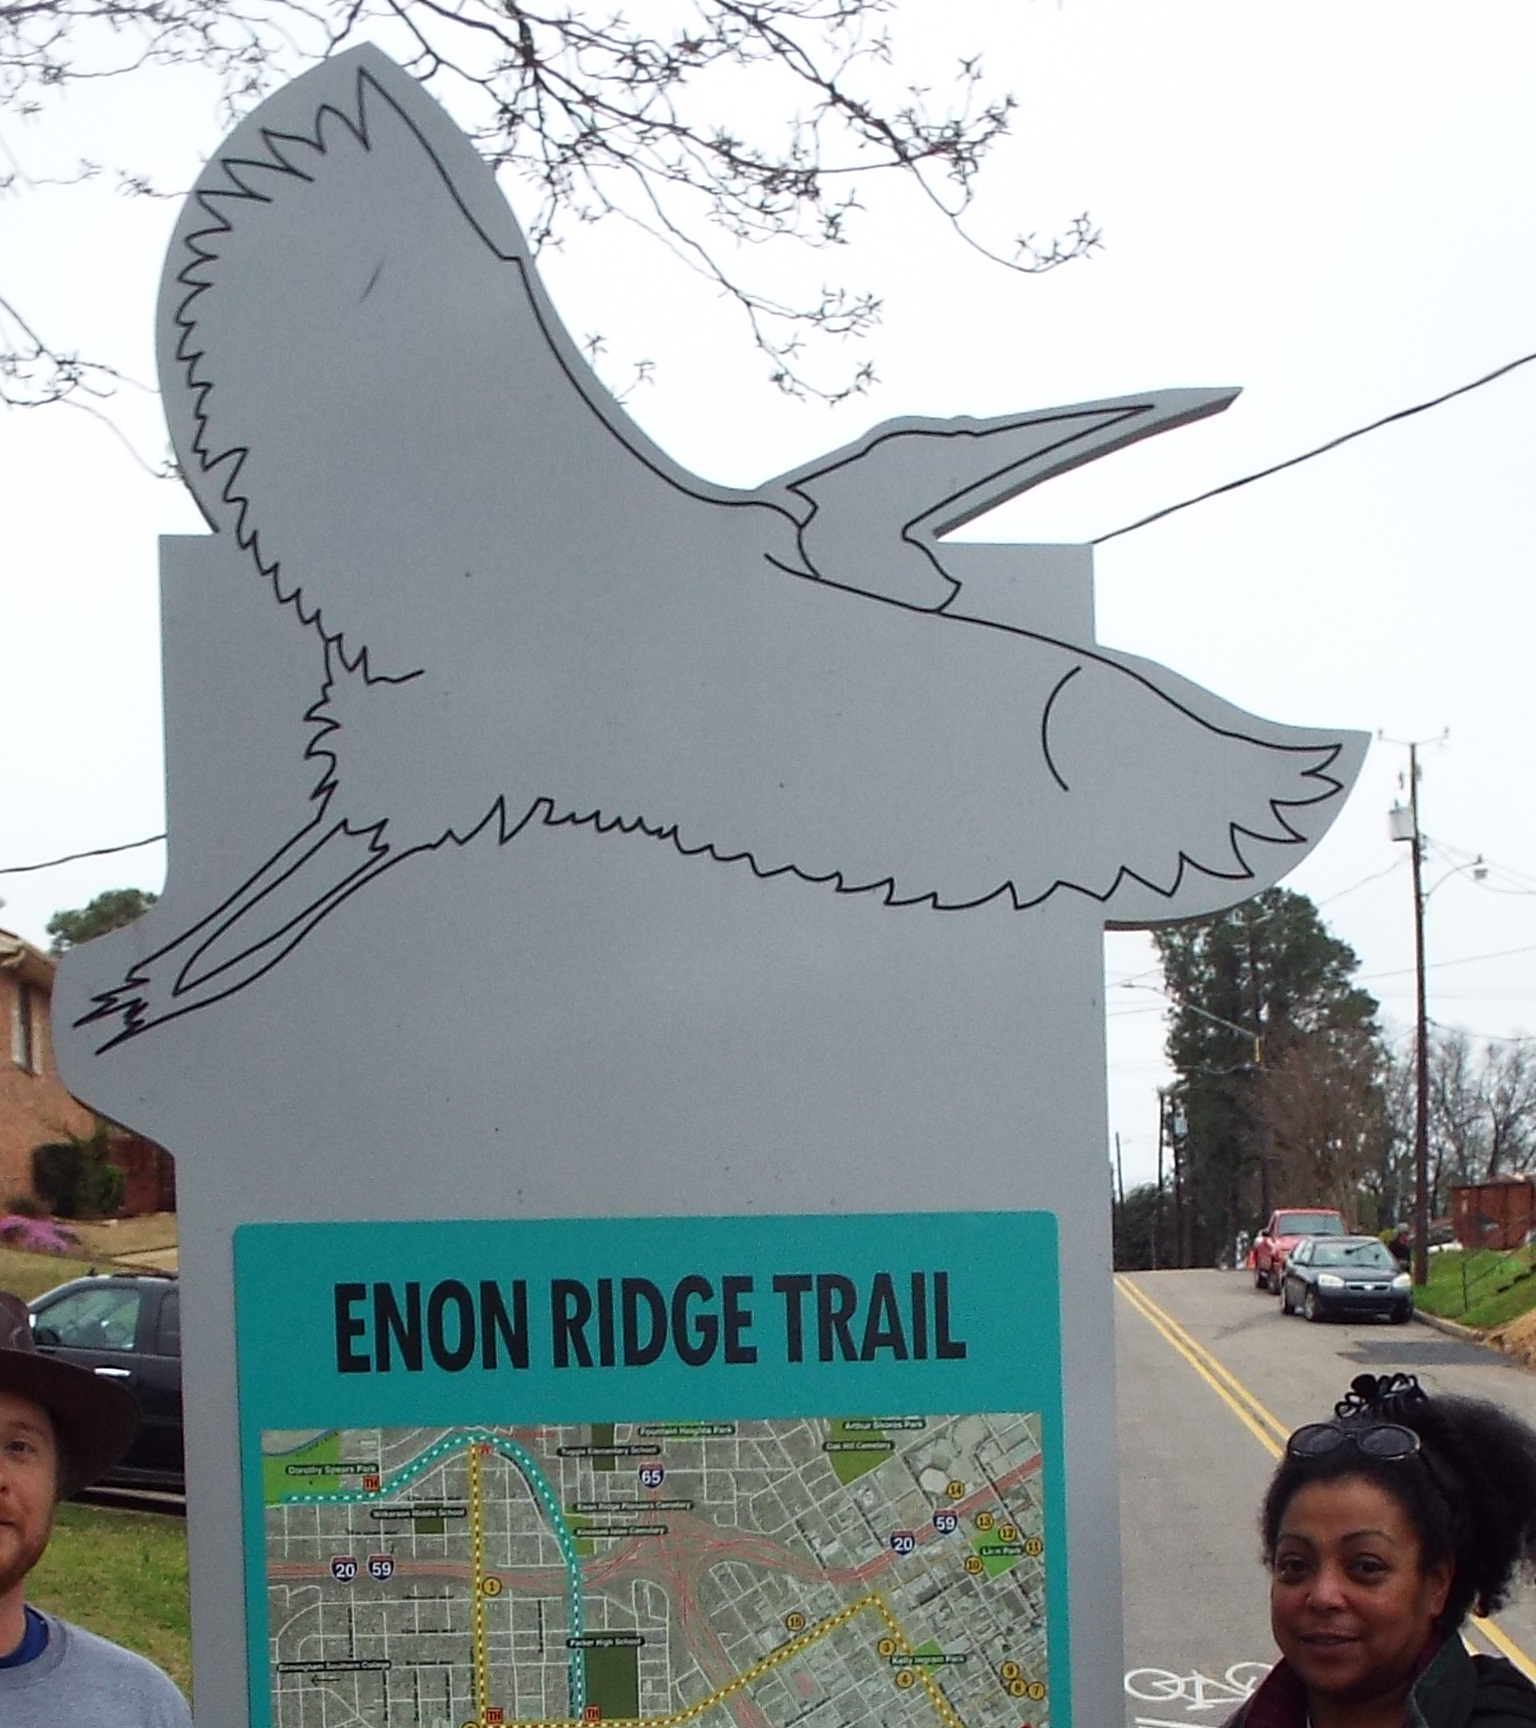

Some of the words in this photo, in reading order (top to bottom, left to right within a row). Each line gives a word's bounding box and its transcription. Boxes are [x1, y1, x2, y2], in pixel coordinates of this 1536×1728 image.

[333, 1278, 529, 1373] ENON
[551, 1273, 757, 1368] RIDGE
[772, 1271, 966, 1363] TRAIL
[904, 1420, 924, 1428] Park
[714, 1426, 733, 1434] Park
[358, 1464, 377, 1472] Park
[641, 1470, 660, 1484] 65
[365, 1479, 378, 1488] TH
[949, 1484, 962, 1497] 14
[937, 1516, 955, 1530] 59
[977, 1515, 992, 1527] 13
[1001, 1527, 1014, 1538] 12
[893, 1537, 913, 1551] 20
[1027, 1540, 1040, 1552] 11
[372, 1561, 391, 1576] 59
[967, 1559, 980, 1570] 10
[336, 1564, 355, 1578] 20
[489, 1582, 494, 1592] 1
[790, 1617, 802, 1627] 15
[1007, 1666, 1014, 1675] 9
[902, 1675, 908, 1684] 4
[1033, 1686, 1040, 1696] 7
[488, 1711, 501, 1721] TH
[587, 1708, 599, 1720] TH
